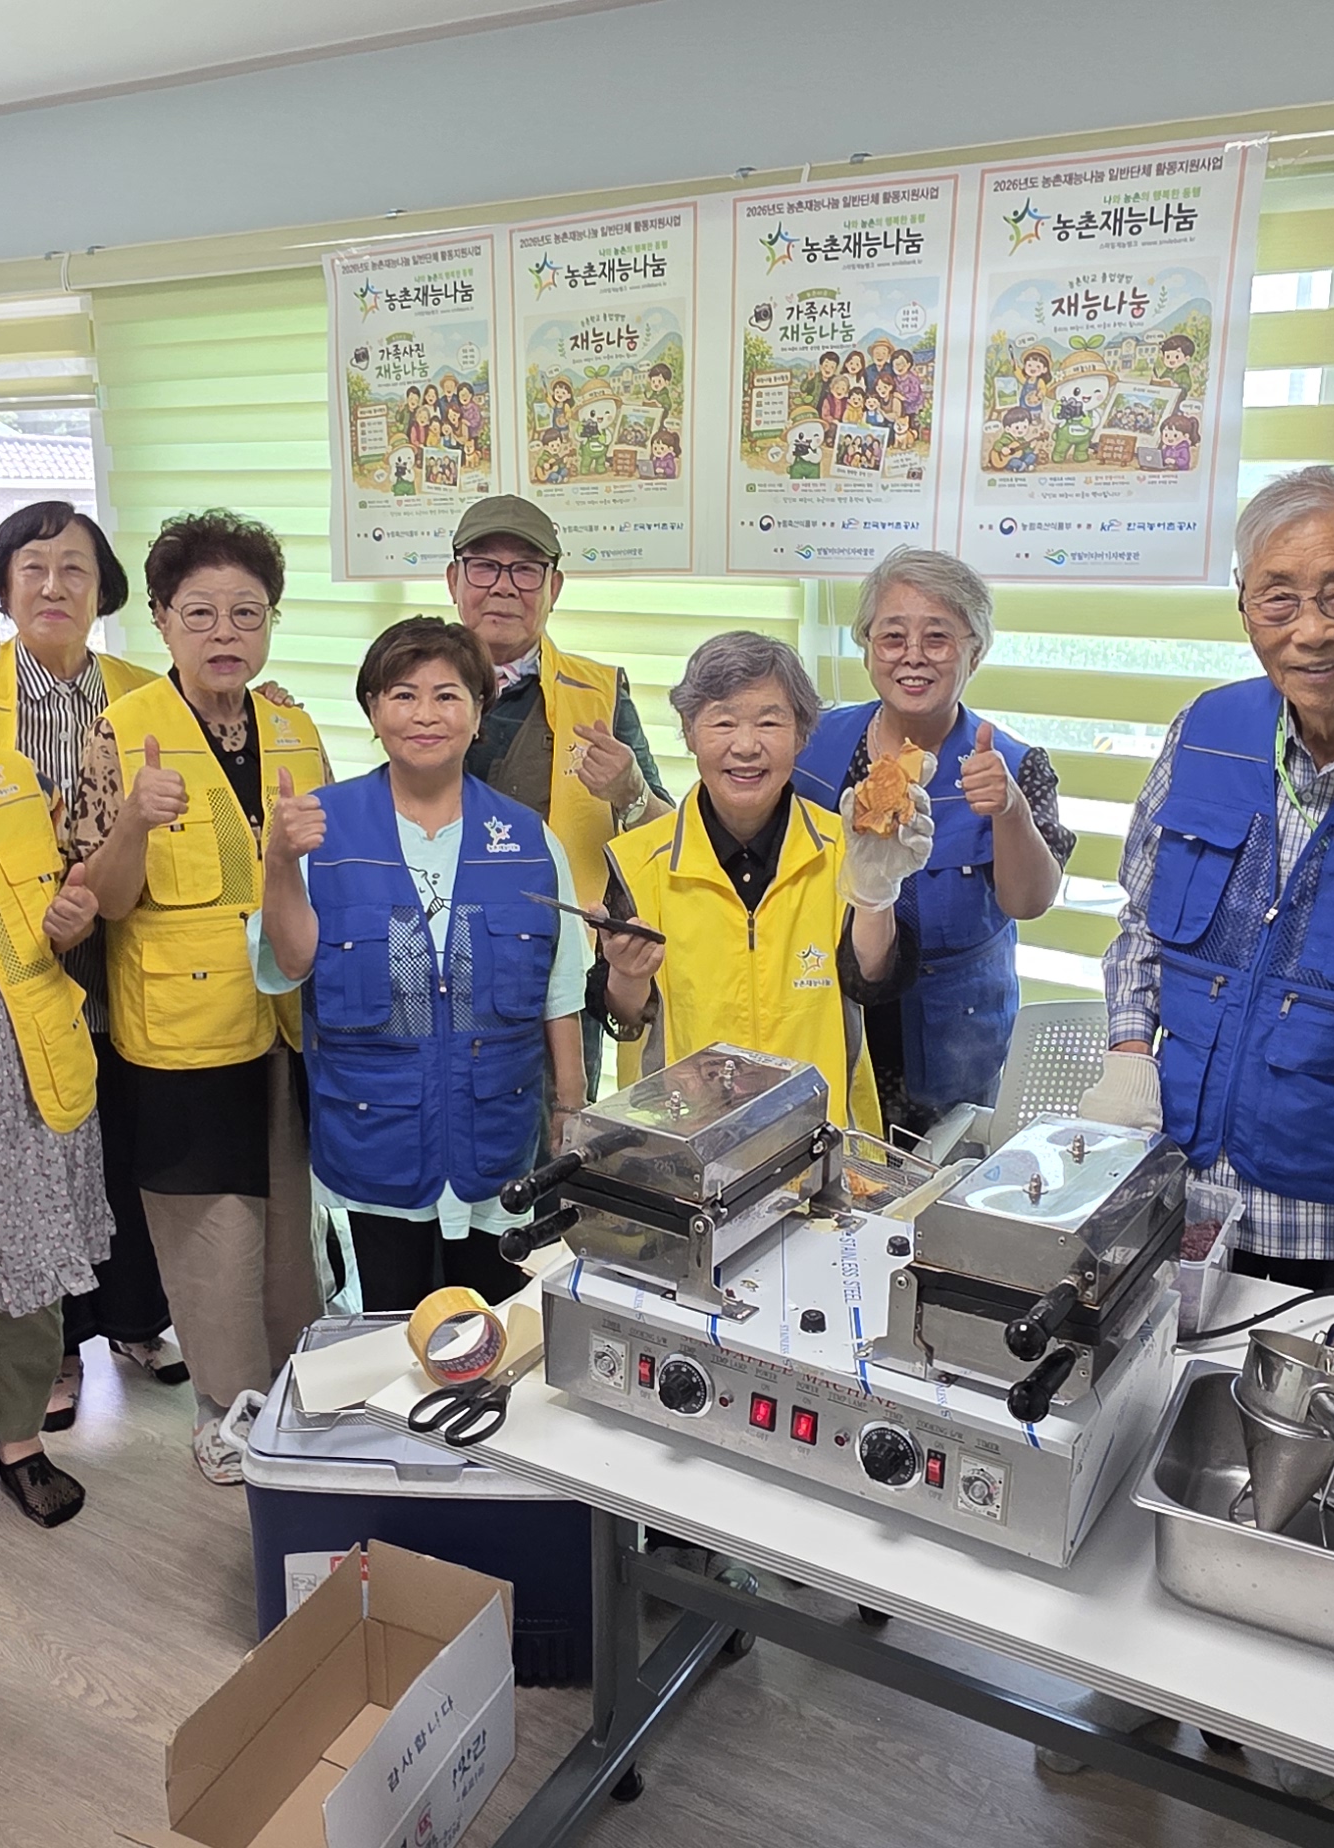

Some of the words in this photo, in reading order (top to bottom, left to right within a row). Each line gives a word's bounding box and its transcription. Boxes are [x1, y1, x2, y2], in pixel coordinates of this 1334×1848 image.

[993, 177, 1038, 192] 2026년도
[1042, 170, 1105, 189] 농촌재능나눔
[1109, 164, 1152, 181] 일반단체
[1156, 156, 1223, 176] 활동지원사업
[746, 202, 784, 217] 2026년도
[787, 197, 840, 214] 농촌재능나눔
[842, 192, 879, 208] 일반단체
[882, 187, 939, 204] 활동지원사업
[1104, 195, 1121, 205] 나와
[1124, 192, 1150, 203] 농촌의
[1153, 189, 1180, 201] 행복한
[1182, 187, 1201, 198] 동행
[1053, 203, 1198, 241] 농촌재능나눔
[802, 228, 924, 263] 농촌재능나눔
[565, 253, 667, 288] 농촌재능나눔
[385, 280, 474, 311] 농촌재능나눔
[1051, 287, 1150, 321] 재능나눔
[785, 301, 851, 322] 가족사진
[569, 324, 640, 353] 재능나눔
[779, 321, 855, 345] 재능나눔
[379, 343, 426, 362] 가족사진
[375, 360, 430, 381] 재능나눔
[839, 1235, 859, 1279] STAINLESS
[843, 1280, 862, 1303] STEEL
[711, 1354, 730, 1367] TEMP
[755, 1368, 778, 1381] POWER
[796, 1382, 819, 1396] POWER
[387, 1695, 453, 1793] 감사합니다
